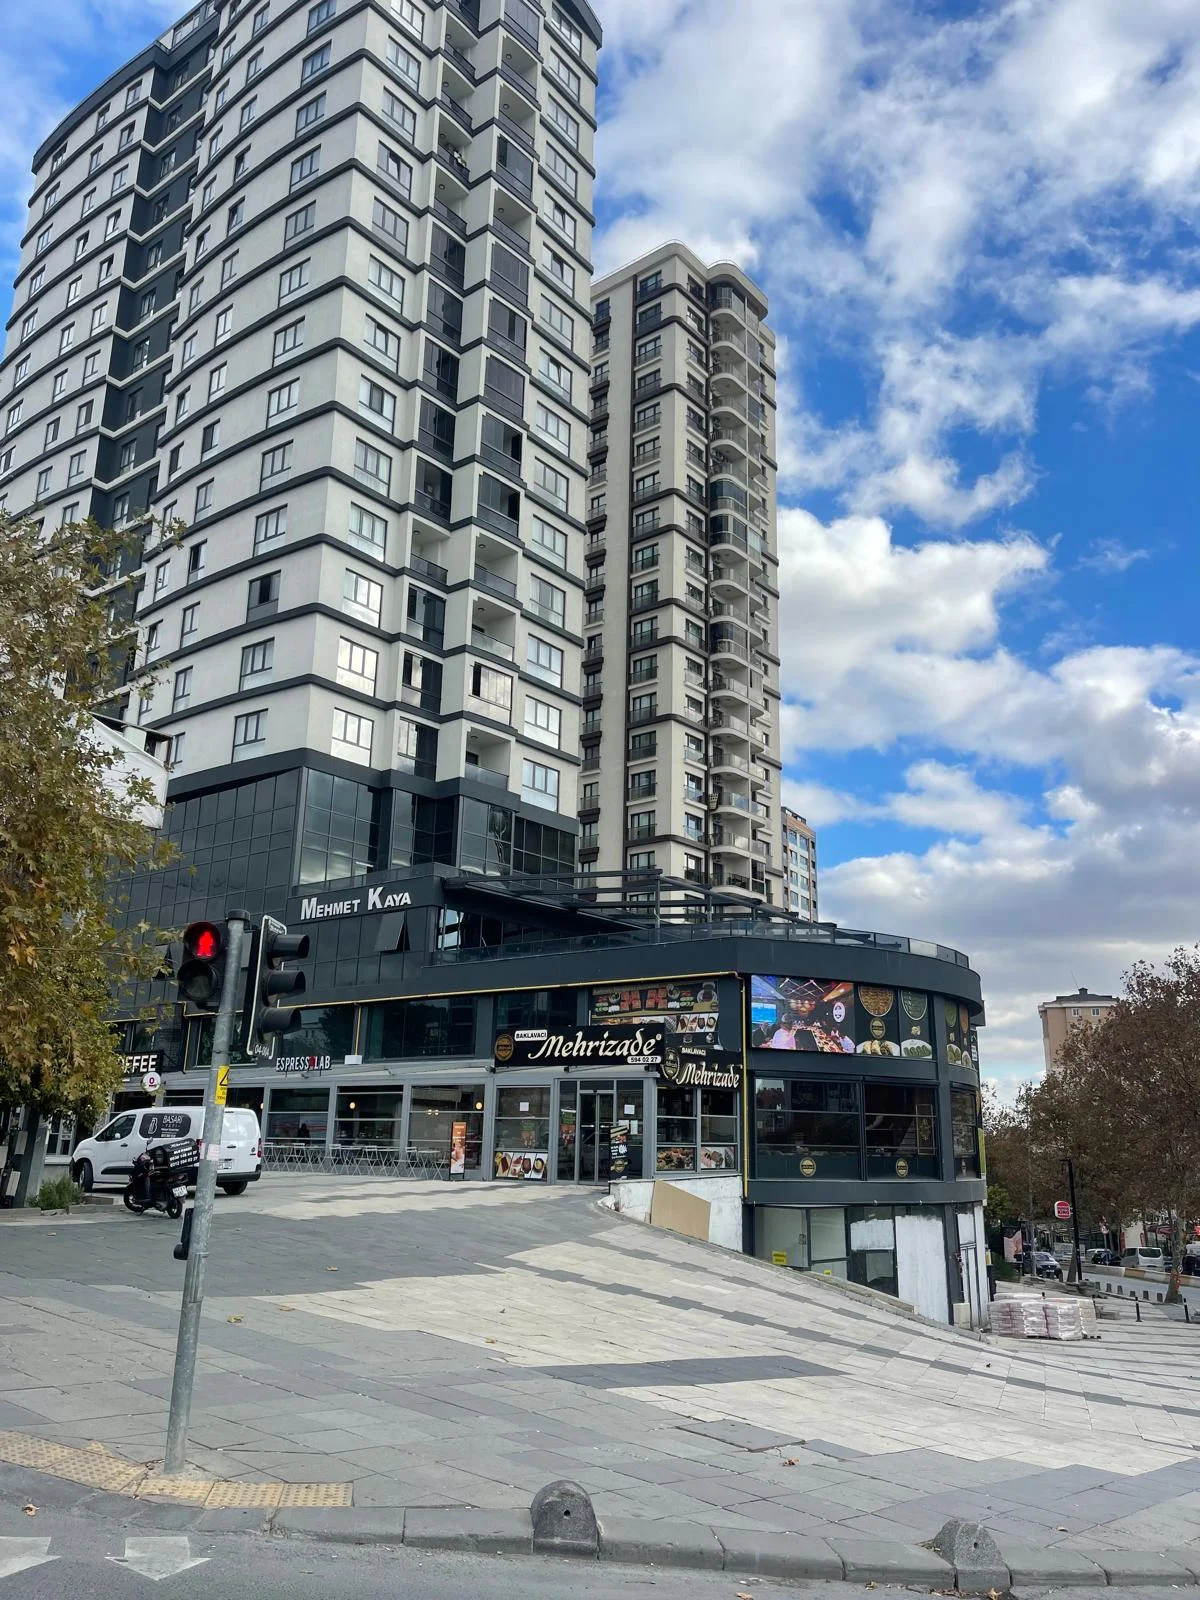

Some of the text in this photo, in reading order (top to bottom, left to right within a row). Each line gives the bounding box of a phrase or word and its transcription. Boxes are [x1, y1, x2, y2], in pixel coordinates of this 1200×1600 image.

[300, 886, 412, 920] MEHMET KAYA
[515, 1031, 547, 1040] BAKLAVACI
[527, 1028, 656, 1060] Mehrizade
[681, 1047, 707, 1056] BAKLAVACI
[117, 1054, 158, 1073] OFFEE
[675, 1061, 740, 1088] Mehrizade
